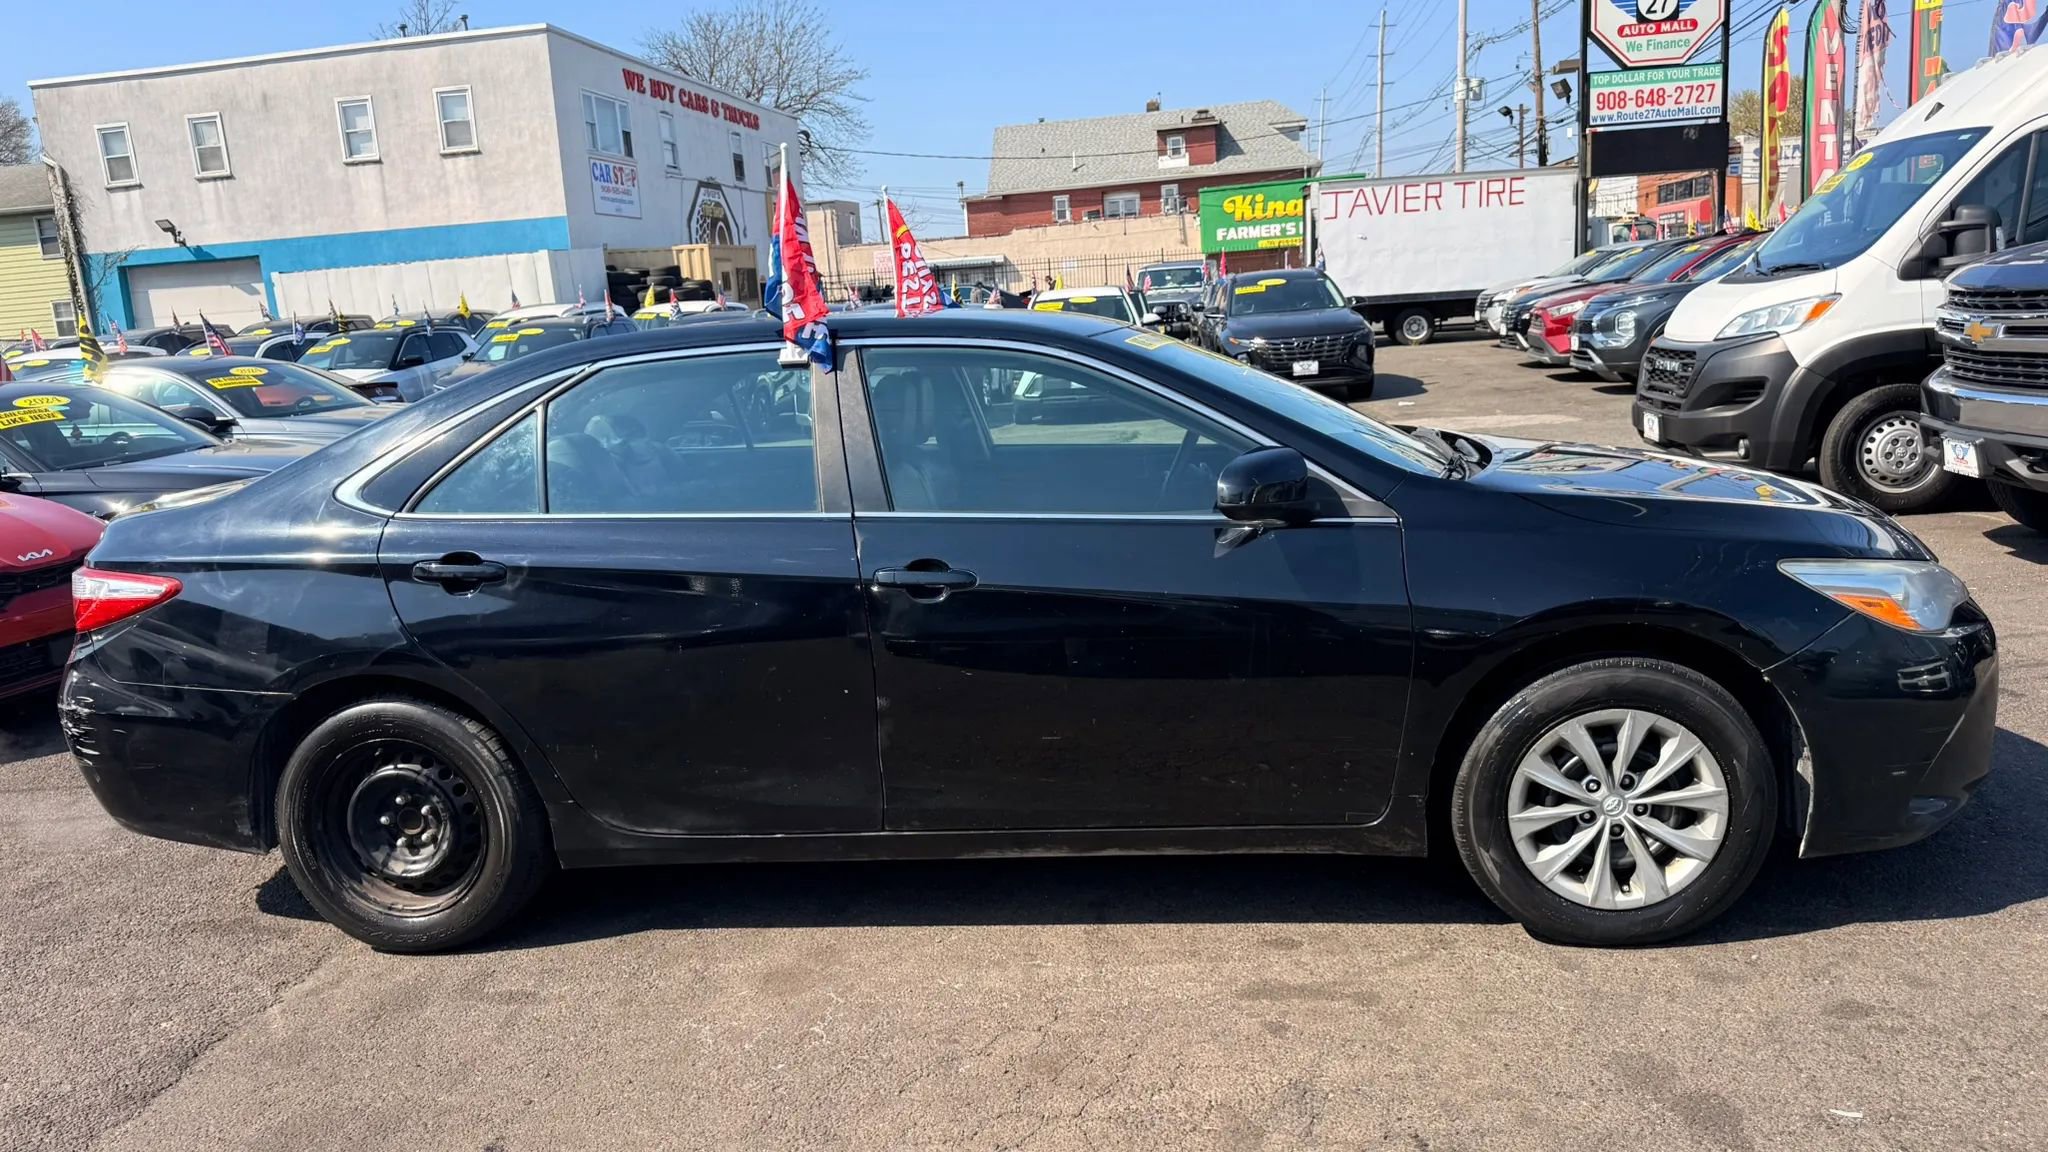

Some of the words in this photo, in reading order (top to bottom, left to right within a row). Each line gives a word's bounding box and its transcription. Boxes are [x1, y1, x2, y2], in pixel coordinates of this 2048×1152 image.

[1622, 23, 1656, 36] AUTO
[1660, 20, 1694, 33] MALL
[1625, 41, 1643, 53] We
[1646, 38, 1690, 50] Finance
[1593, 75, 1610, 85] TOP
[1611, 71, 1645, 84] DOLLAR
[1647, 69, 1664, 81] FOR
[1666, 67, 1690, 79] YOUR
[1692, 66, 1721, 77] TRADE
[622, 68, 646, 94] WE
[649, 78, 676, 103] BUY
[678, 88, 709, 114] CARS
[721, 102, 760, 131] TRUCKS
[1596, 83, 1716, 111] 908-648-2727
[1591, 105, 1721, 122] www.Route27AutoMall.com
[592, 162, 613, 184] CAR
[1321, 182, 1443, 220] JAVIER
[1454, 176, 1526, 210] TIRE
[1216, 222, 1296, 241] FARMER'S
[1, 416, 28, 426] LIKE
[29, 411, 57, 421] NEW
